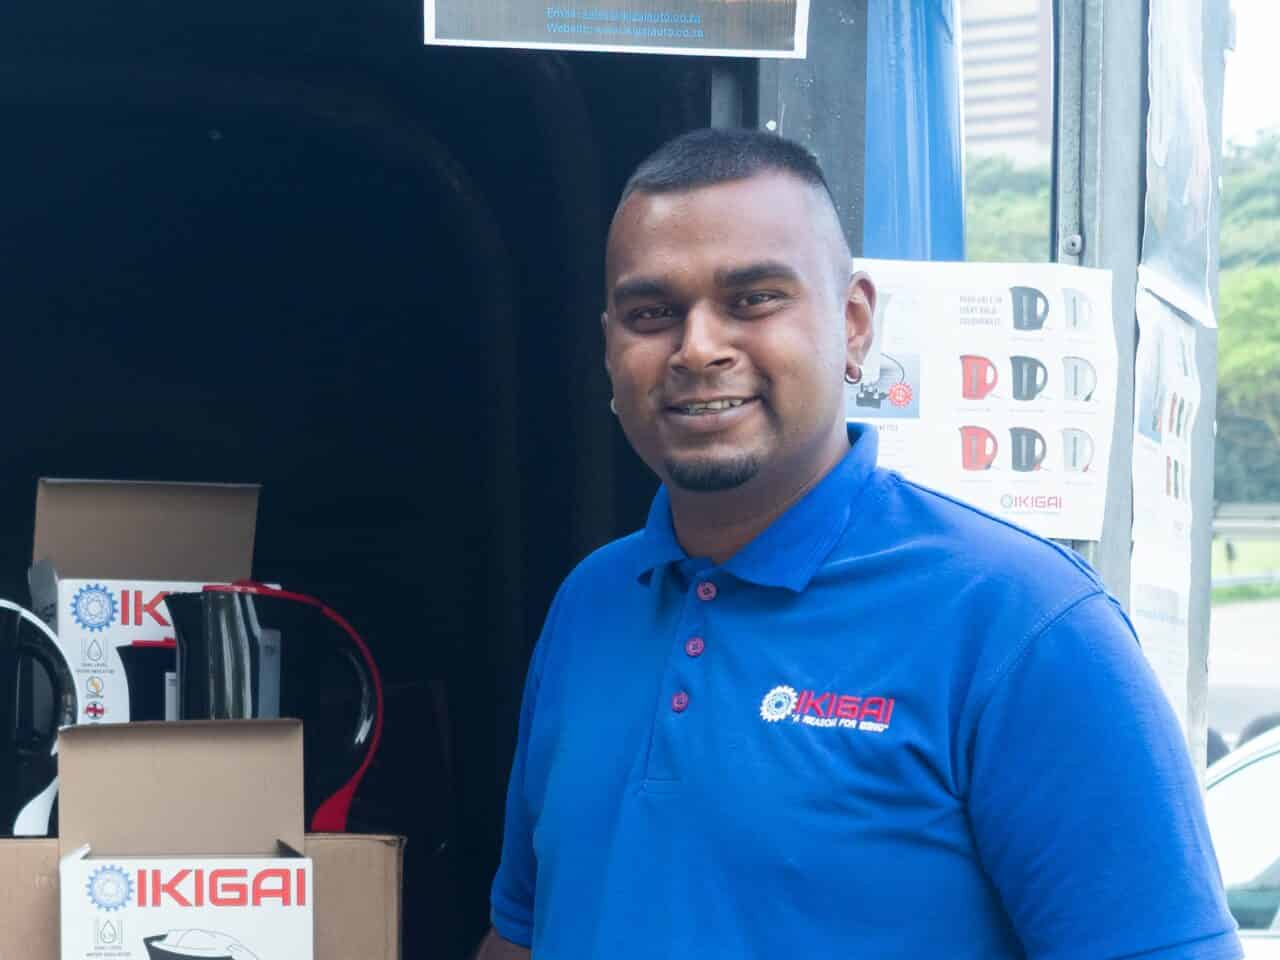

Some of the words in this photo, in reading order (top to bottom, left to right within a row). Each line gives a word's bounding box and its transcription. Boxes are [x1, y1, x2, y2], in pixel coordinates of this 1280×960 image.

[1014, 496, 1062, 510] IKIGAI
[795, 689, 896, 725] IKIGAI
[137, 868, 306, 907] IKIGAI
